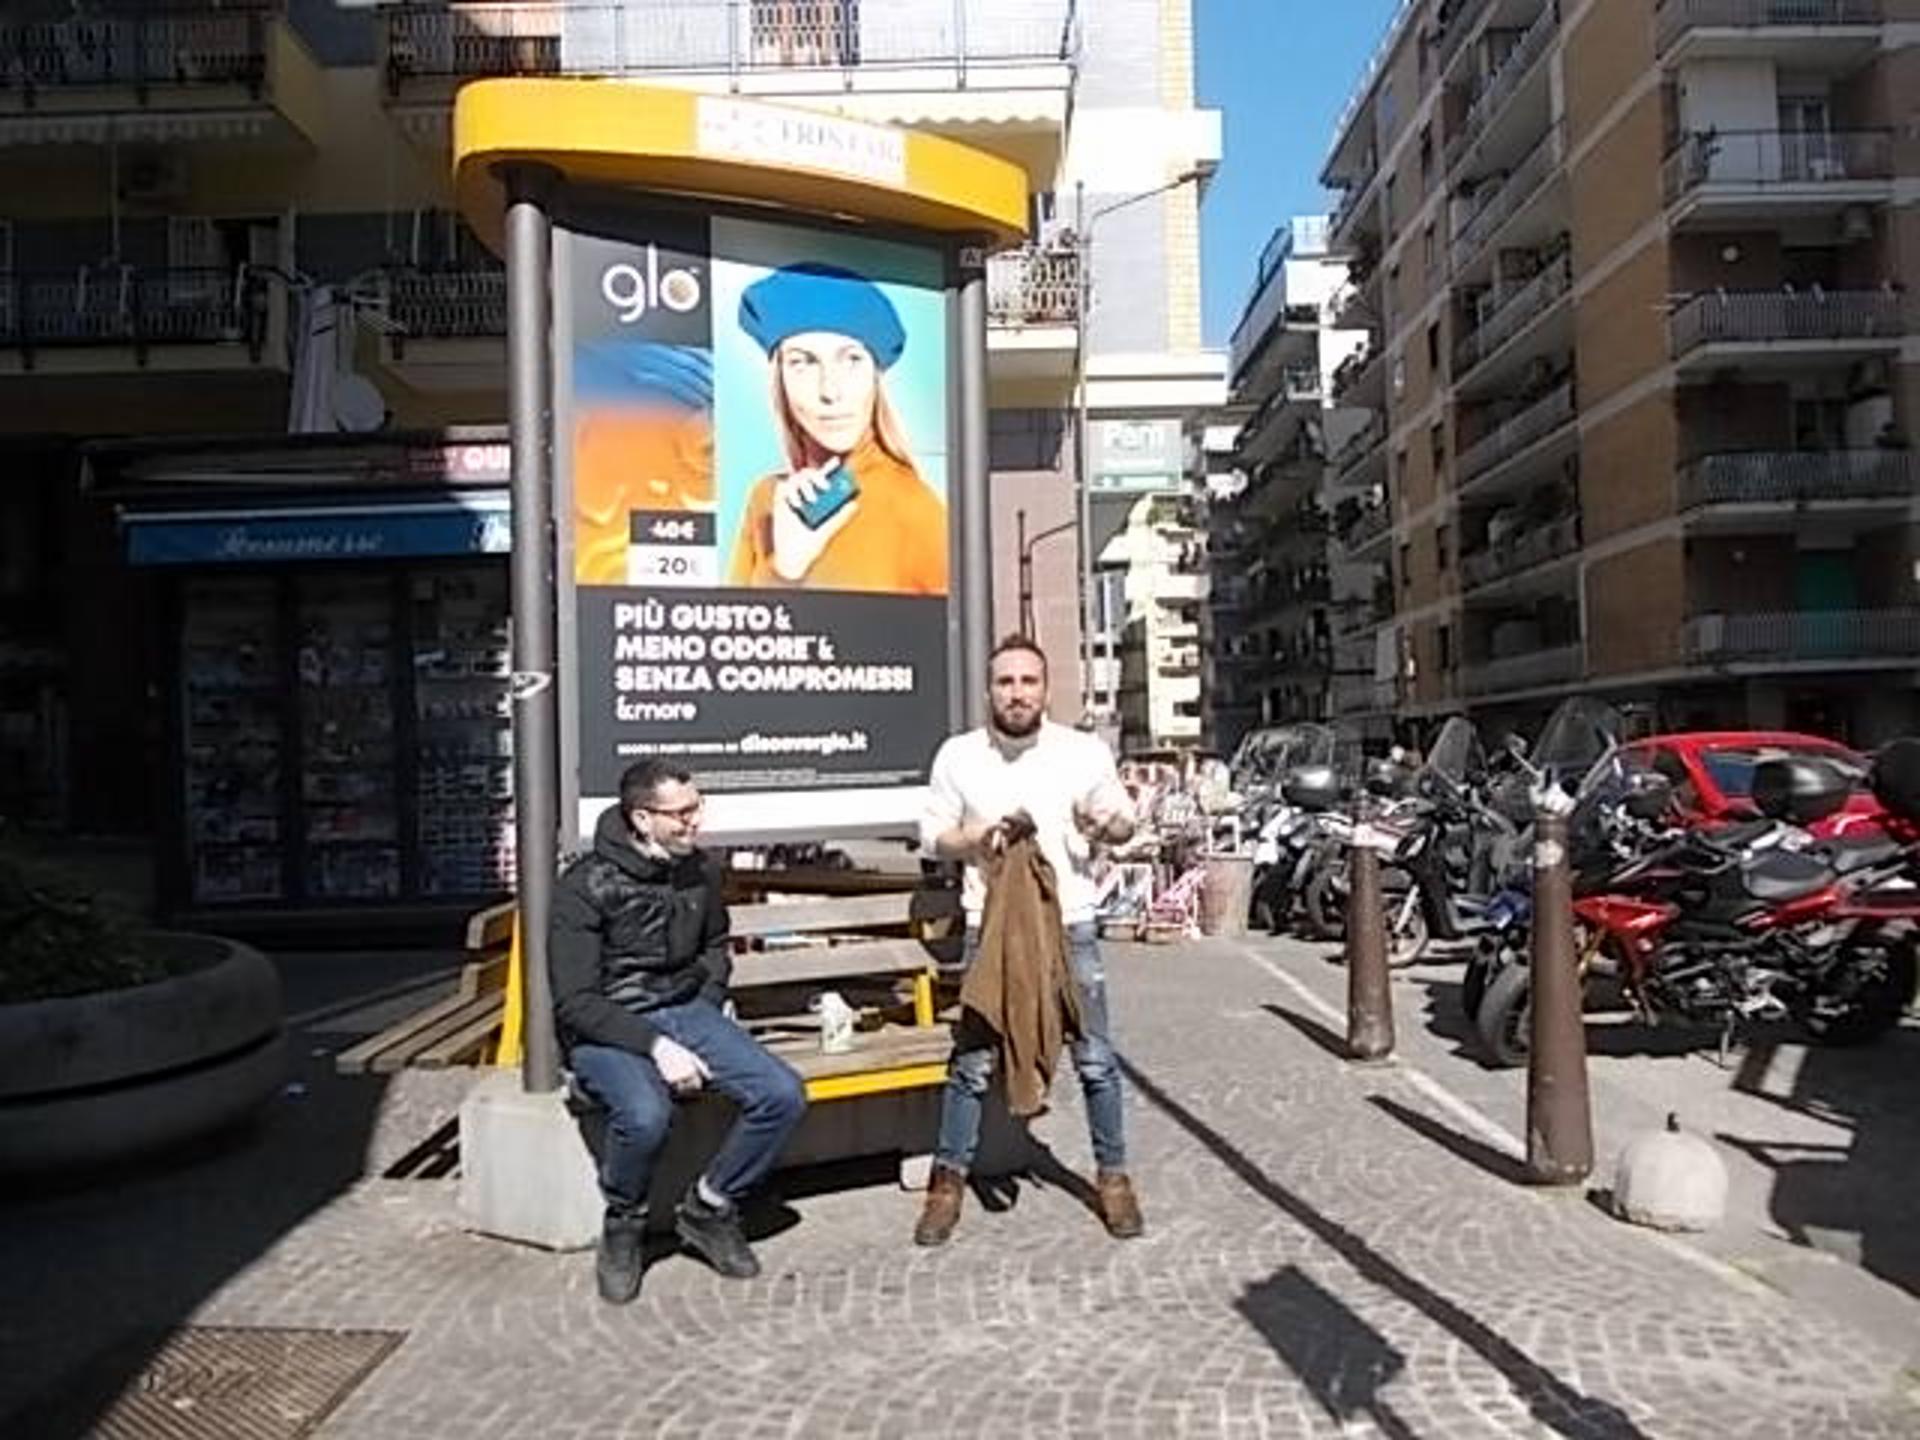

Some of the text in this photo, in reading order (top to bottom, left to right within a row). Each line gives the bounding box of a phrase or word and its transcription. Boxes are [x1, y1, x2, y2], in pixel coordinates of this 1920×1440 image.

[614, 598, 664, 630] PIÙ
[670, 604, 772, 631] GUSTO
[614, 635, 706, 660] MENO
[614, 665, 913, 691] SENZA COMPROMESSI
